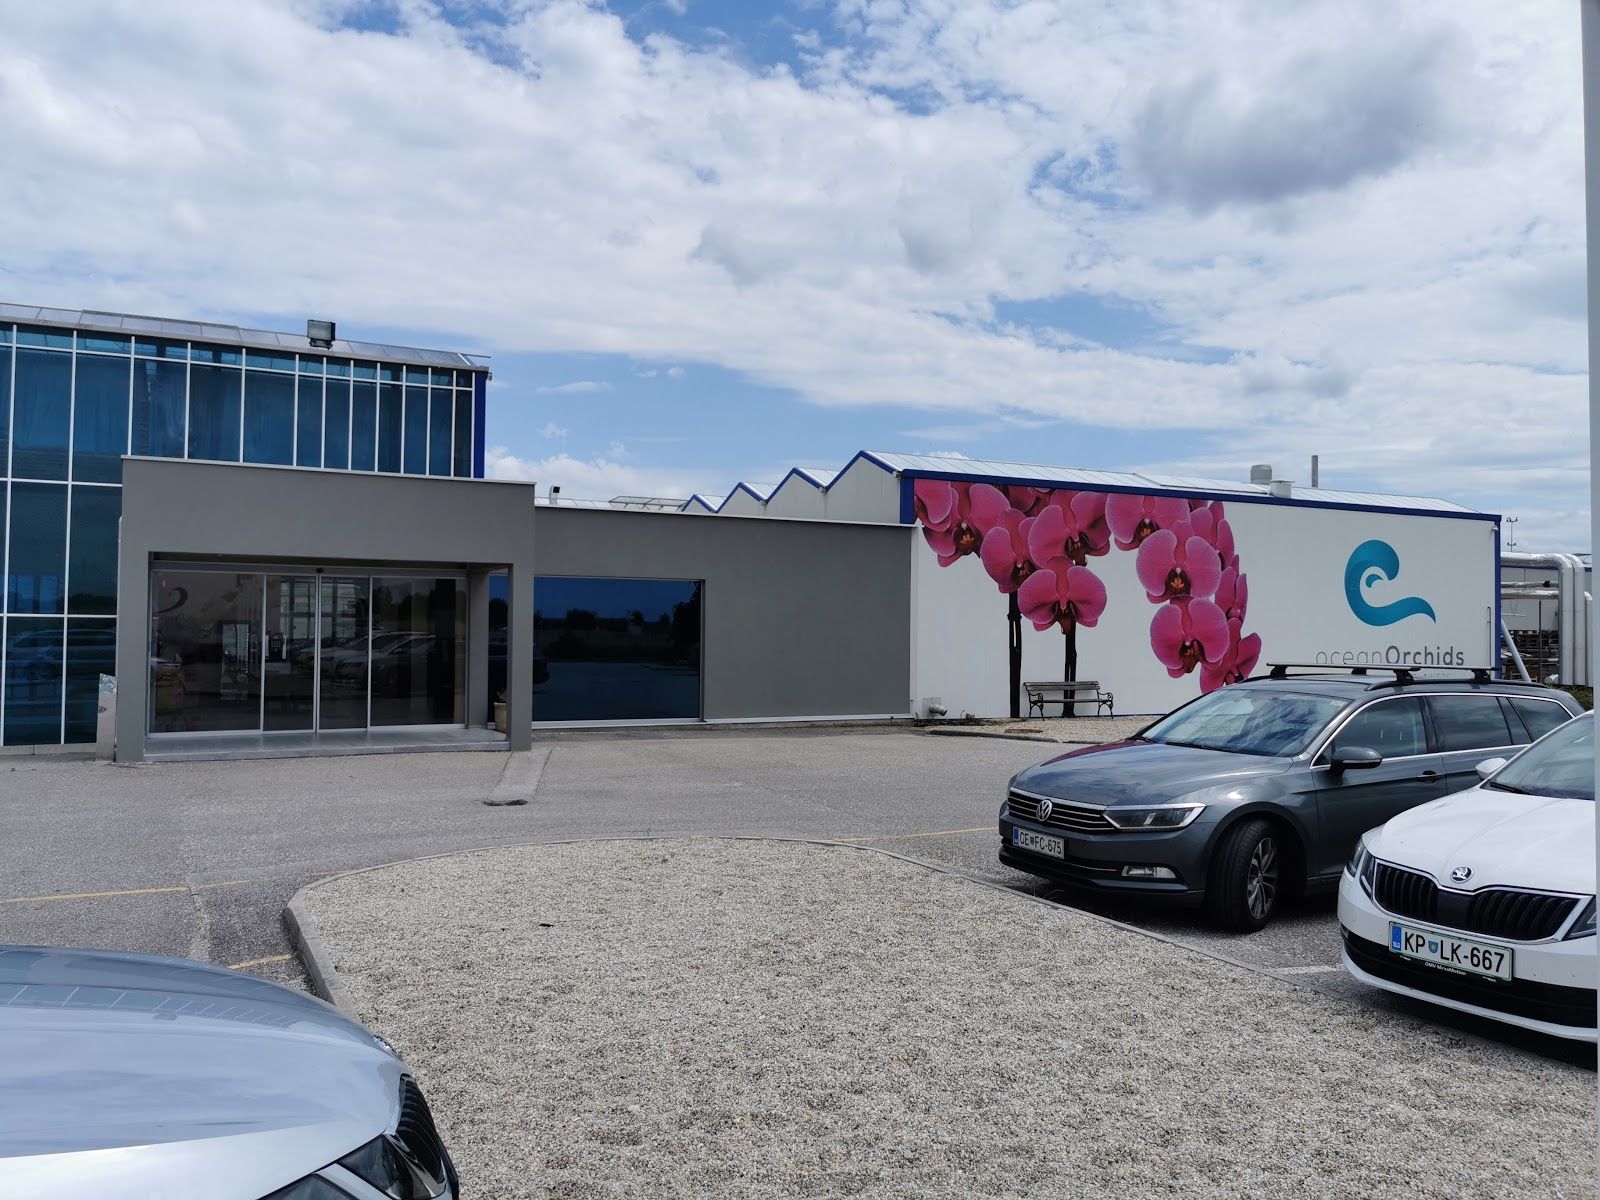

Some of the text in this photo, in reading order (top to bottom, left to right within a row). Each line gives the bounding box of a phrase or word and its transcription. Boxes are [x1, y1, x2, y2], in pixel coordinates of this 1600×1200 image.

[1315, 645, 1465, 666] oceanOrchids
[1034, 835, 1062, 855] FC-675
[1404, 931, 1505, 973] KP LK-667
